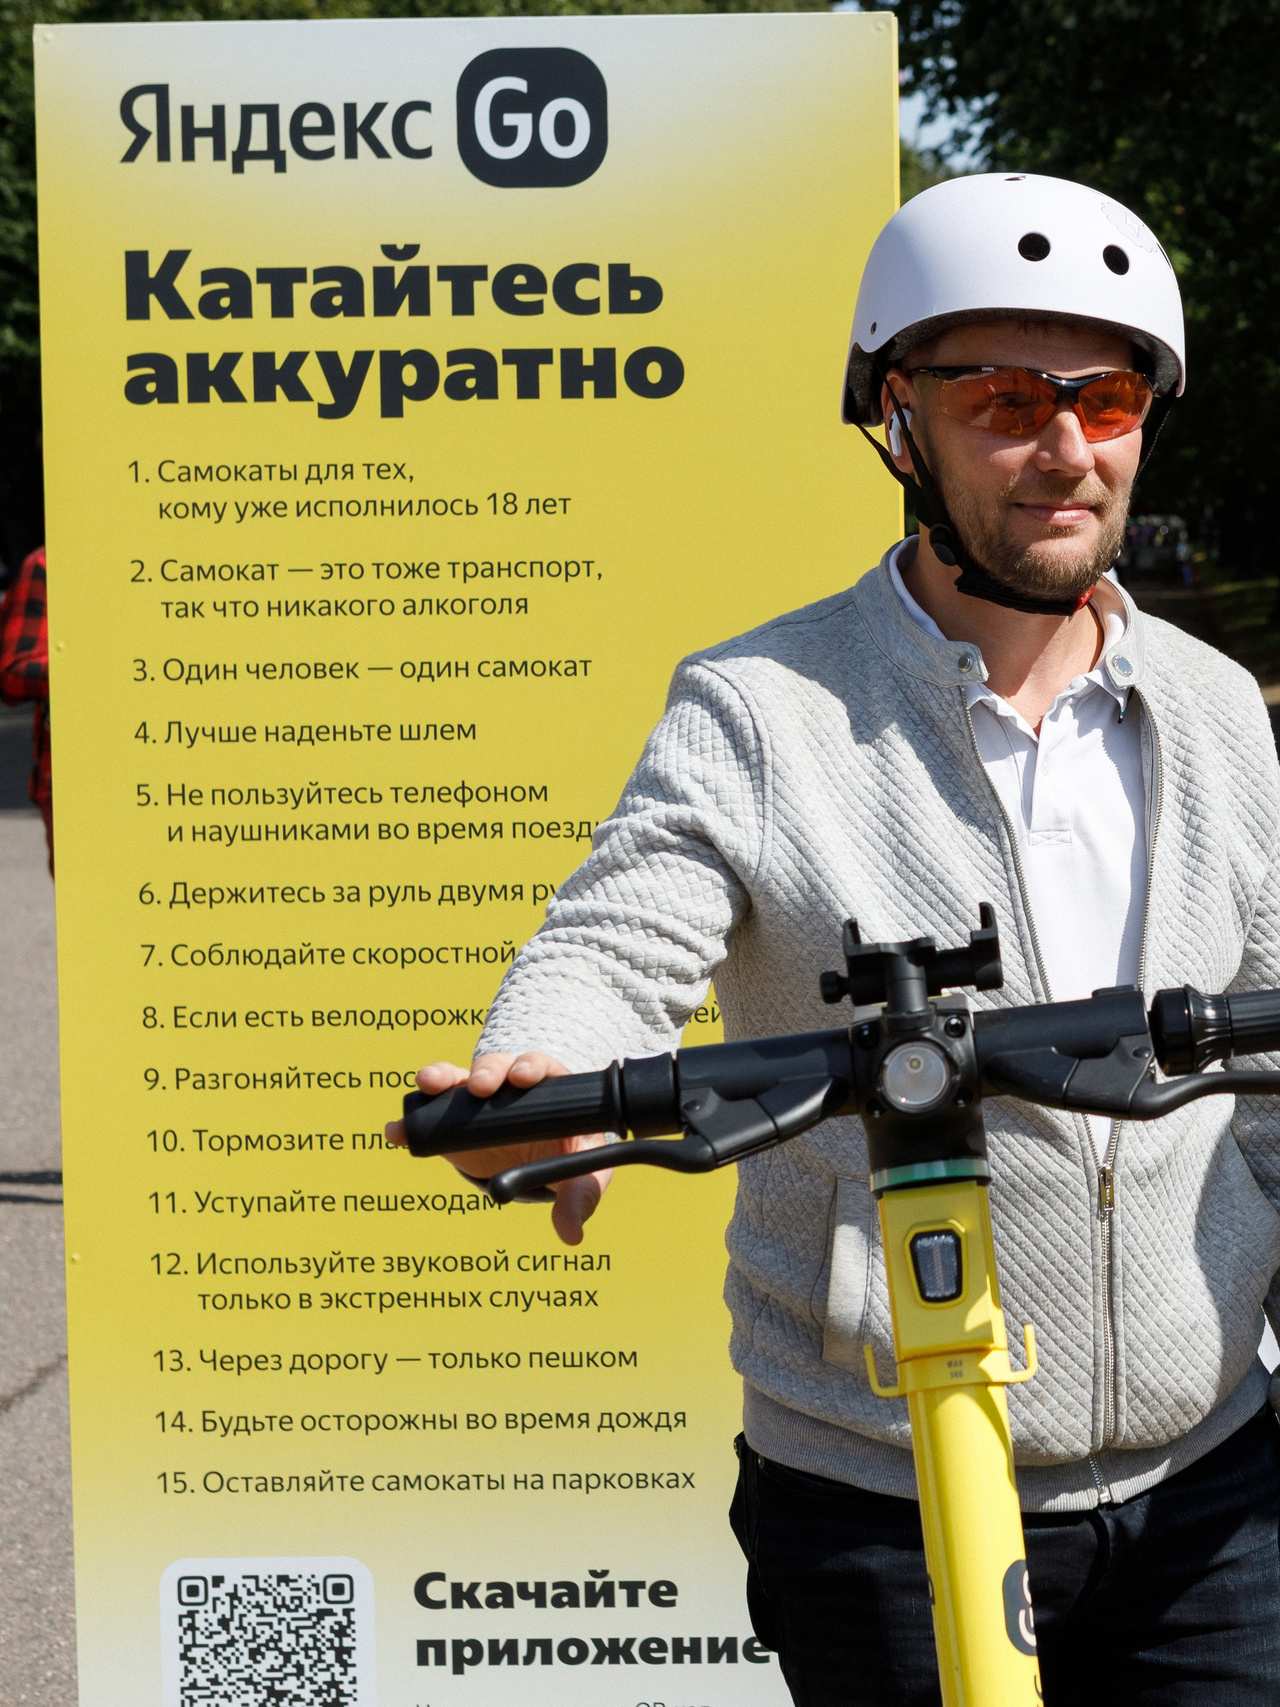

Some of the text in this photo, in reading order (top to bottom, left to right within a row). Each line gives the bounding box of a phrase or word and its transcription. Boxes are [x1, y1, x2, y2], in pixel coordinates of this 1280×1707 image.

[119, 75, 593, 174] Яндекс Go
[124, 243, 665, 321] Катайтесь
[124, 344, 686, 420] аккуратно
[128, 459, 414, 486] 1. Самокаты для тех,
[159, 492, 572, 525] кому уже исполнилось 18 лет
[130, 559, 153, 583] 2.
[161, 559, 280, 583] Самокат
[320, 562, 365, 581] это
[372, 561, 441, 580] тоже
[447, 559, 603, 584] транспорт,
[160, 597, 528, 619] так что никакого алкоголя
[133, 658, 156, 682] 3.
[163, 657, 238, 686] Один
[246, 661, 360, 680] человек
[400, 660, 470, 683] один
[477, 659, 593, 678] самокат
[134, 720, 476, 749] 4. Лучше наденьте шлем
[136, 779, 548, 811] 5. Не пользуйтесь телефоном
[167, 820, 600, 847] и наушниками во время поезд
[139, 882, 162, 905] 6.
[169, 881, 326, 910] Держитесь
[333, 885, 361, 903] за
[369, 884, 432, 908] руль
[438, 884, 524, 907] двумя
[140, 937, 516, 970] 7. Соблюдайте скоростной
[142, 1005, 165, 1029] 8.
[173, 1005, 237, 1029] Если
[244, 1010, 304, 1028] есть
[311, 1007, 489, 1033] велодорожк
[143, 1067, 167, 1091] 9.
[175, 1065, 362, 1091] Разгоняйтесь
[147, 1129, 185, 1153] 10.
[193, 1129, 344, 1157] Тормозите
[148, 1187, 502, 1219] 11. Уступайте пешеходам
[150, 1249, 611, 1279] 12. Используйте звуковой сигнал
[197, 1289, 599, 1314] только в экстренных случаях
[153, 1349, 192, 1372] 13.
[199, 1349, 283, 1377] Через
[289, 1353, 389, 1376] дорогу
[428, 1351, 522, 1370] только
[529, 1350, 638, 1369] пешком
[155, 1410, 687, 1438] 14. Будьте осторожны во время дождя
[157, 1468, 696, 1495] 15. Оставляйте самокаты на парковках
[413, 1569, 679, 1610] Скачайте
[416, 1636, 772, 1676] приложение
